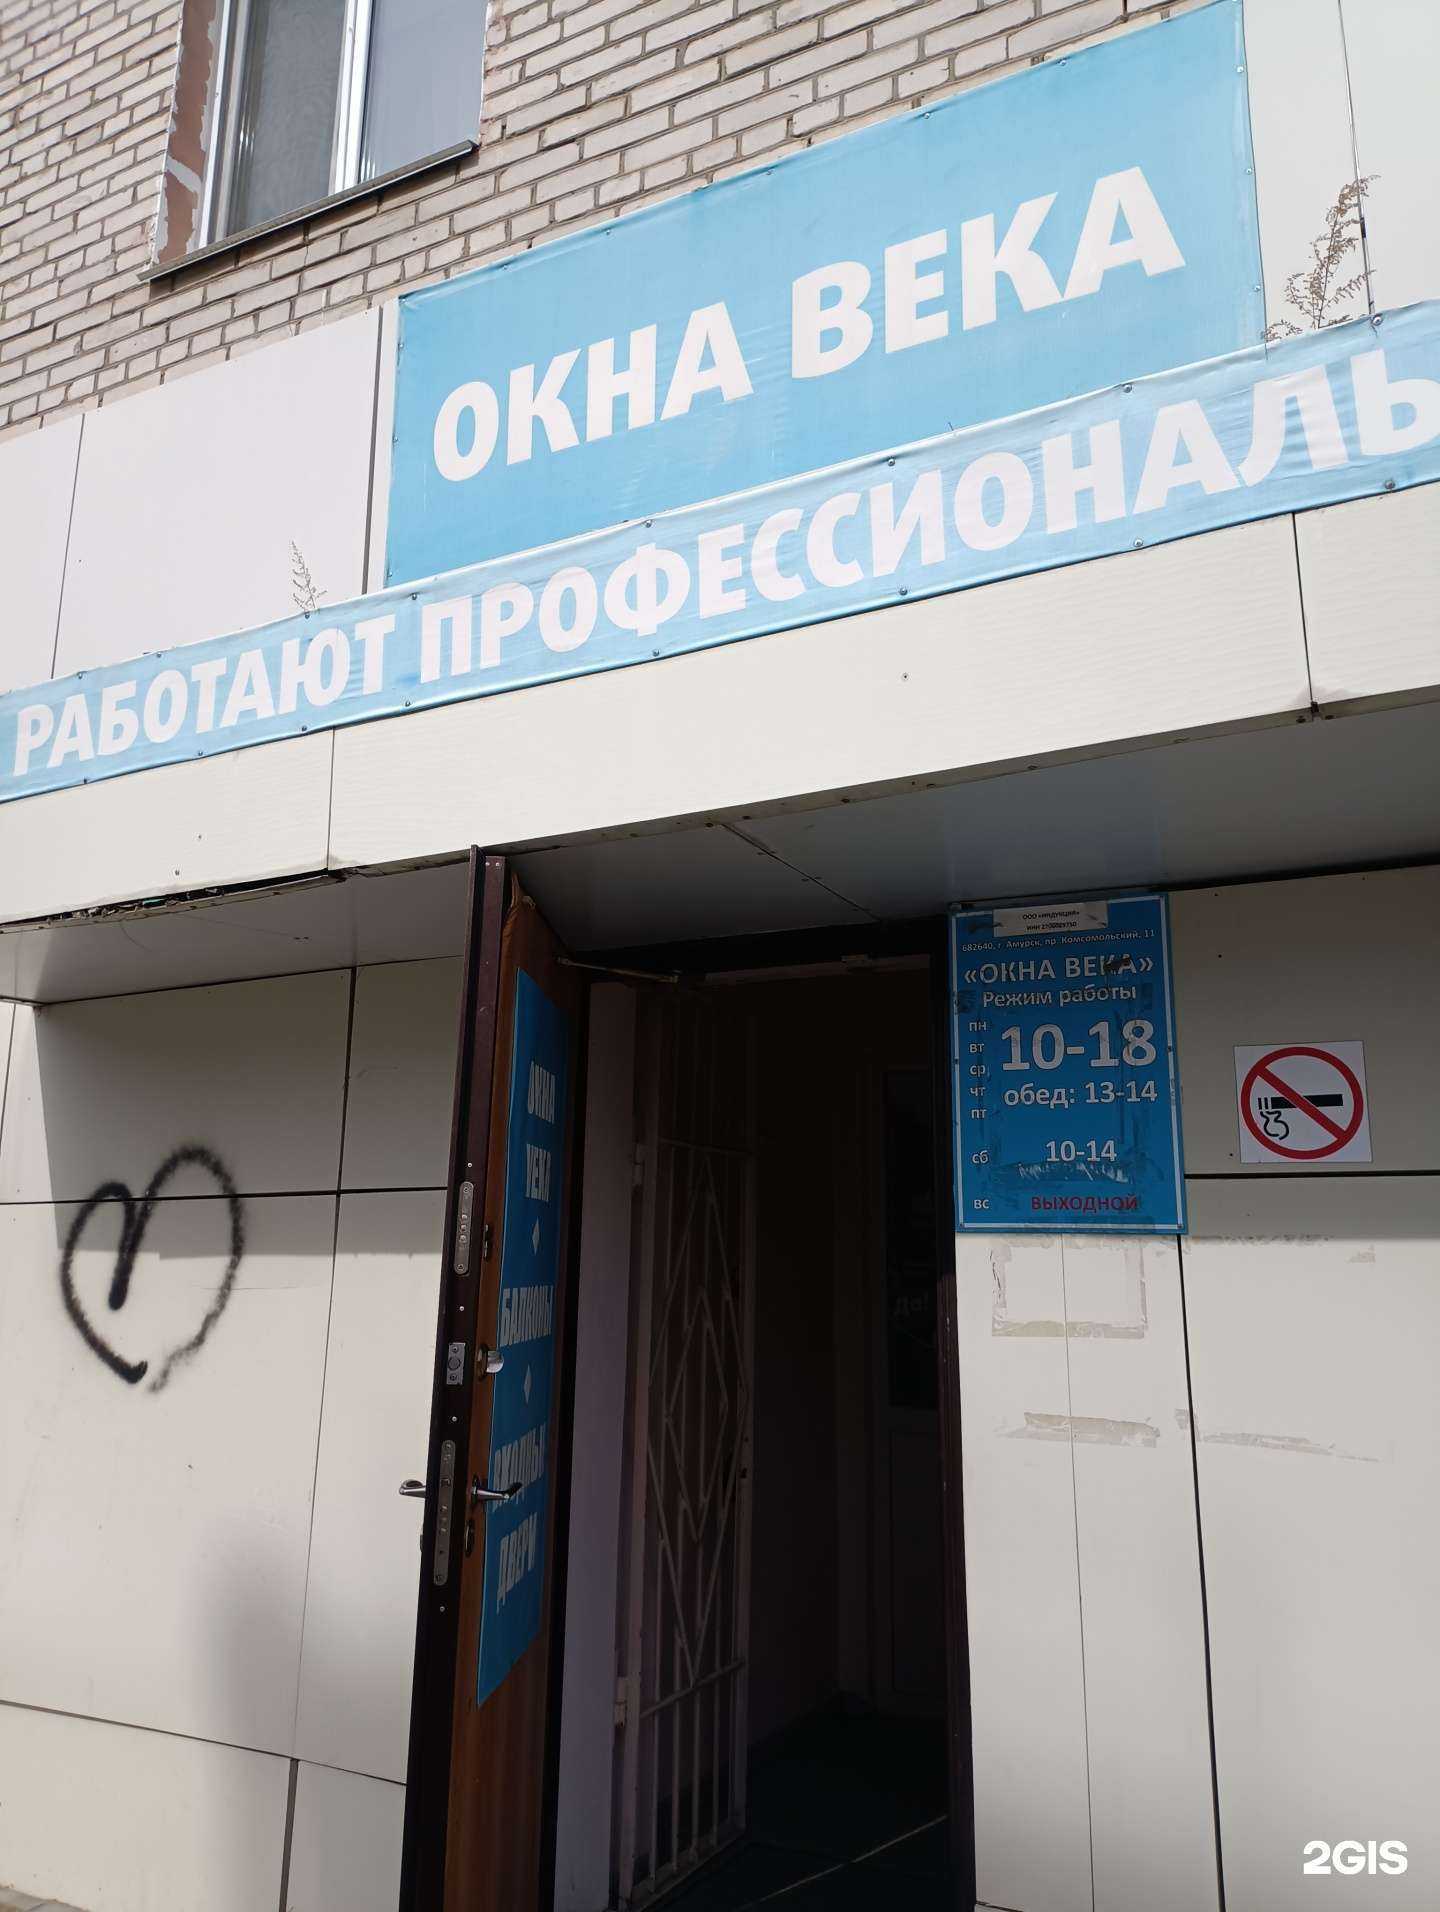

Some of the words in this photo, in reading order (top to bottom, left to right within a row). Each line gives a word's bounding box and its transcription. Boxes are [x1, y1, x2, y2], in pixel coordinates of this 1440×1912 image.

[433, 301, 754, 482] ОКНА
[791, 166, 1186, 379] ВЕКА
[12, 614, 396, 777] РАБОТАЮТ
[964, 959, 1056, 984] «ОКНА
[1065, 952, 1154, 979] ВЕКА»
[982, 990, 1052, 1008] Режим
[1059, 984, 1136, 1006] работы
[1001, 1019, 1157, 1071] 10-18
[527, 1061, 556, 1124] ОКНА
[1004, 1083, 1076, 1109] обед:
[1085, 1079, 1158, 1104] 13-14
[971, 1150, 990, 1165] сб
[1045, 1139, 1118, 1163] 10-14
[499, 1284, 556, 1347] БАЛКОНЫ
[496, 1512, 537, 1615] ДВЕРИ
